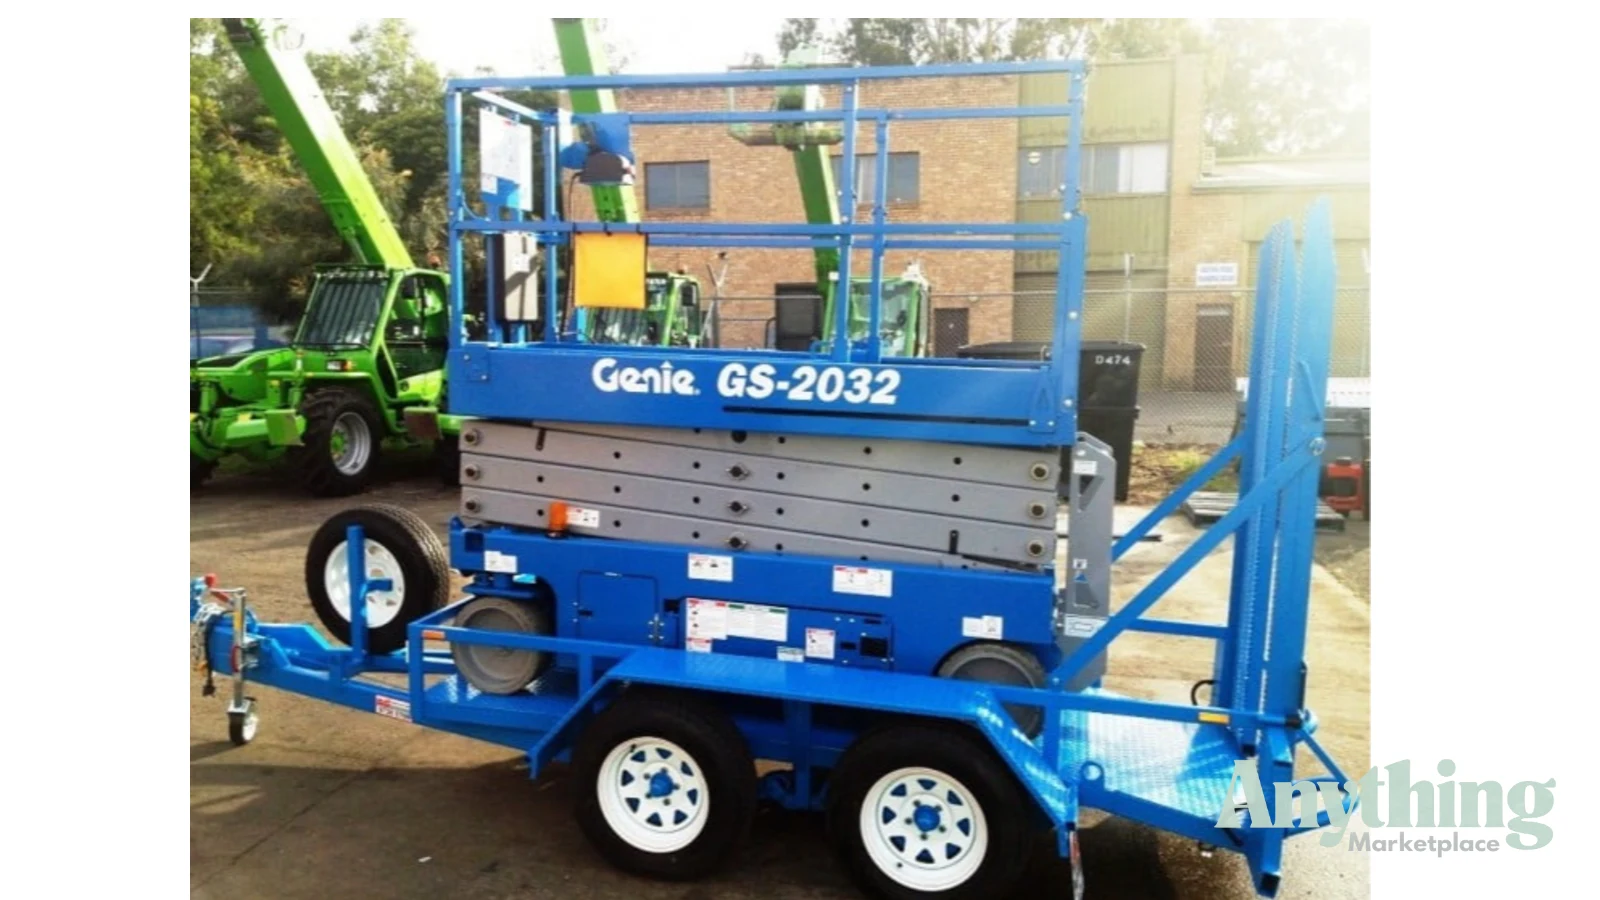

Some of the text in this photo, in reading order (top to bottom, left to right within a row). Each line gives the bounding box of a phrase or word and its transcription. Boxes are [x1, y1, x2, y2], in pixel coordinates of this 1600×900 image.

[1094, 354, 1131, 365] D474
[591, 357, 900, 405] Genie GS-2032
